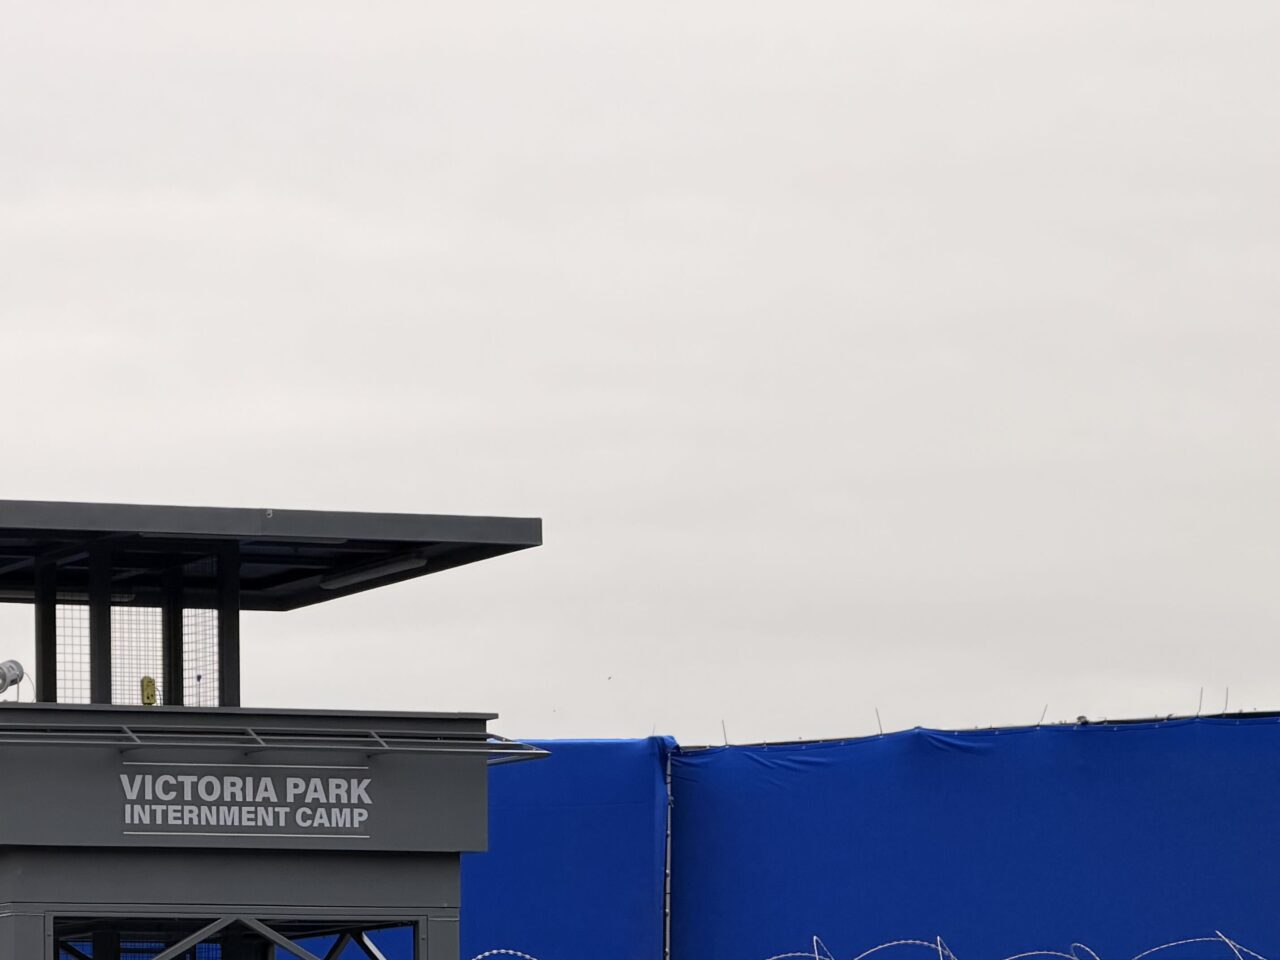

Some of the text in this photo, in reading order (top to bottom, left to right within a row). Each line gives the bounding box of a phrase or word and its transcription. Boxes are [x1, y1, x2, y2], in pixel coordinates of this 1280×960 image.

[119, 774, 372, 804] VICTORIA PARK
[124, 804, 368, 828] INTERNMENT CAMP
